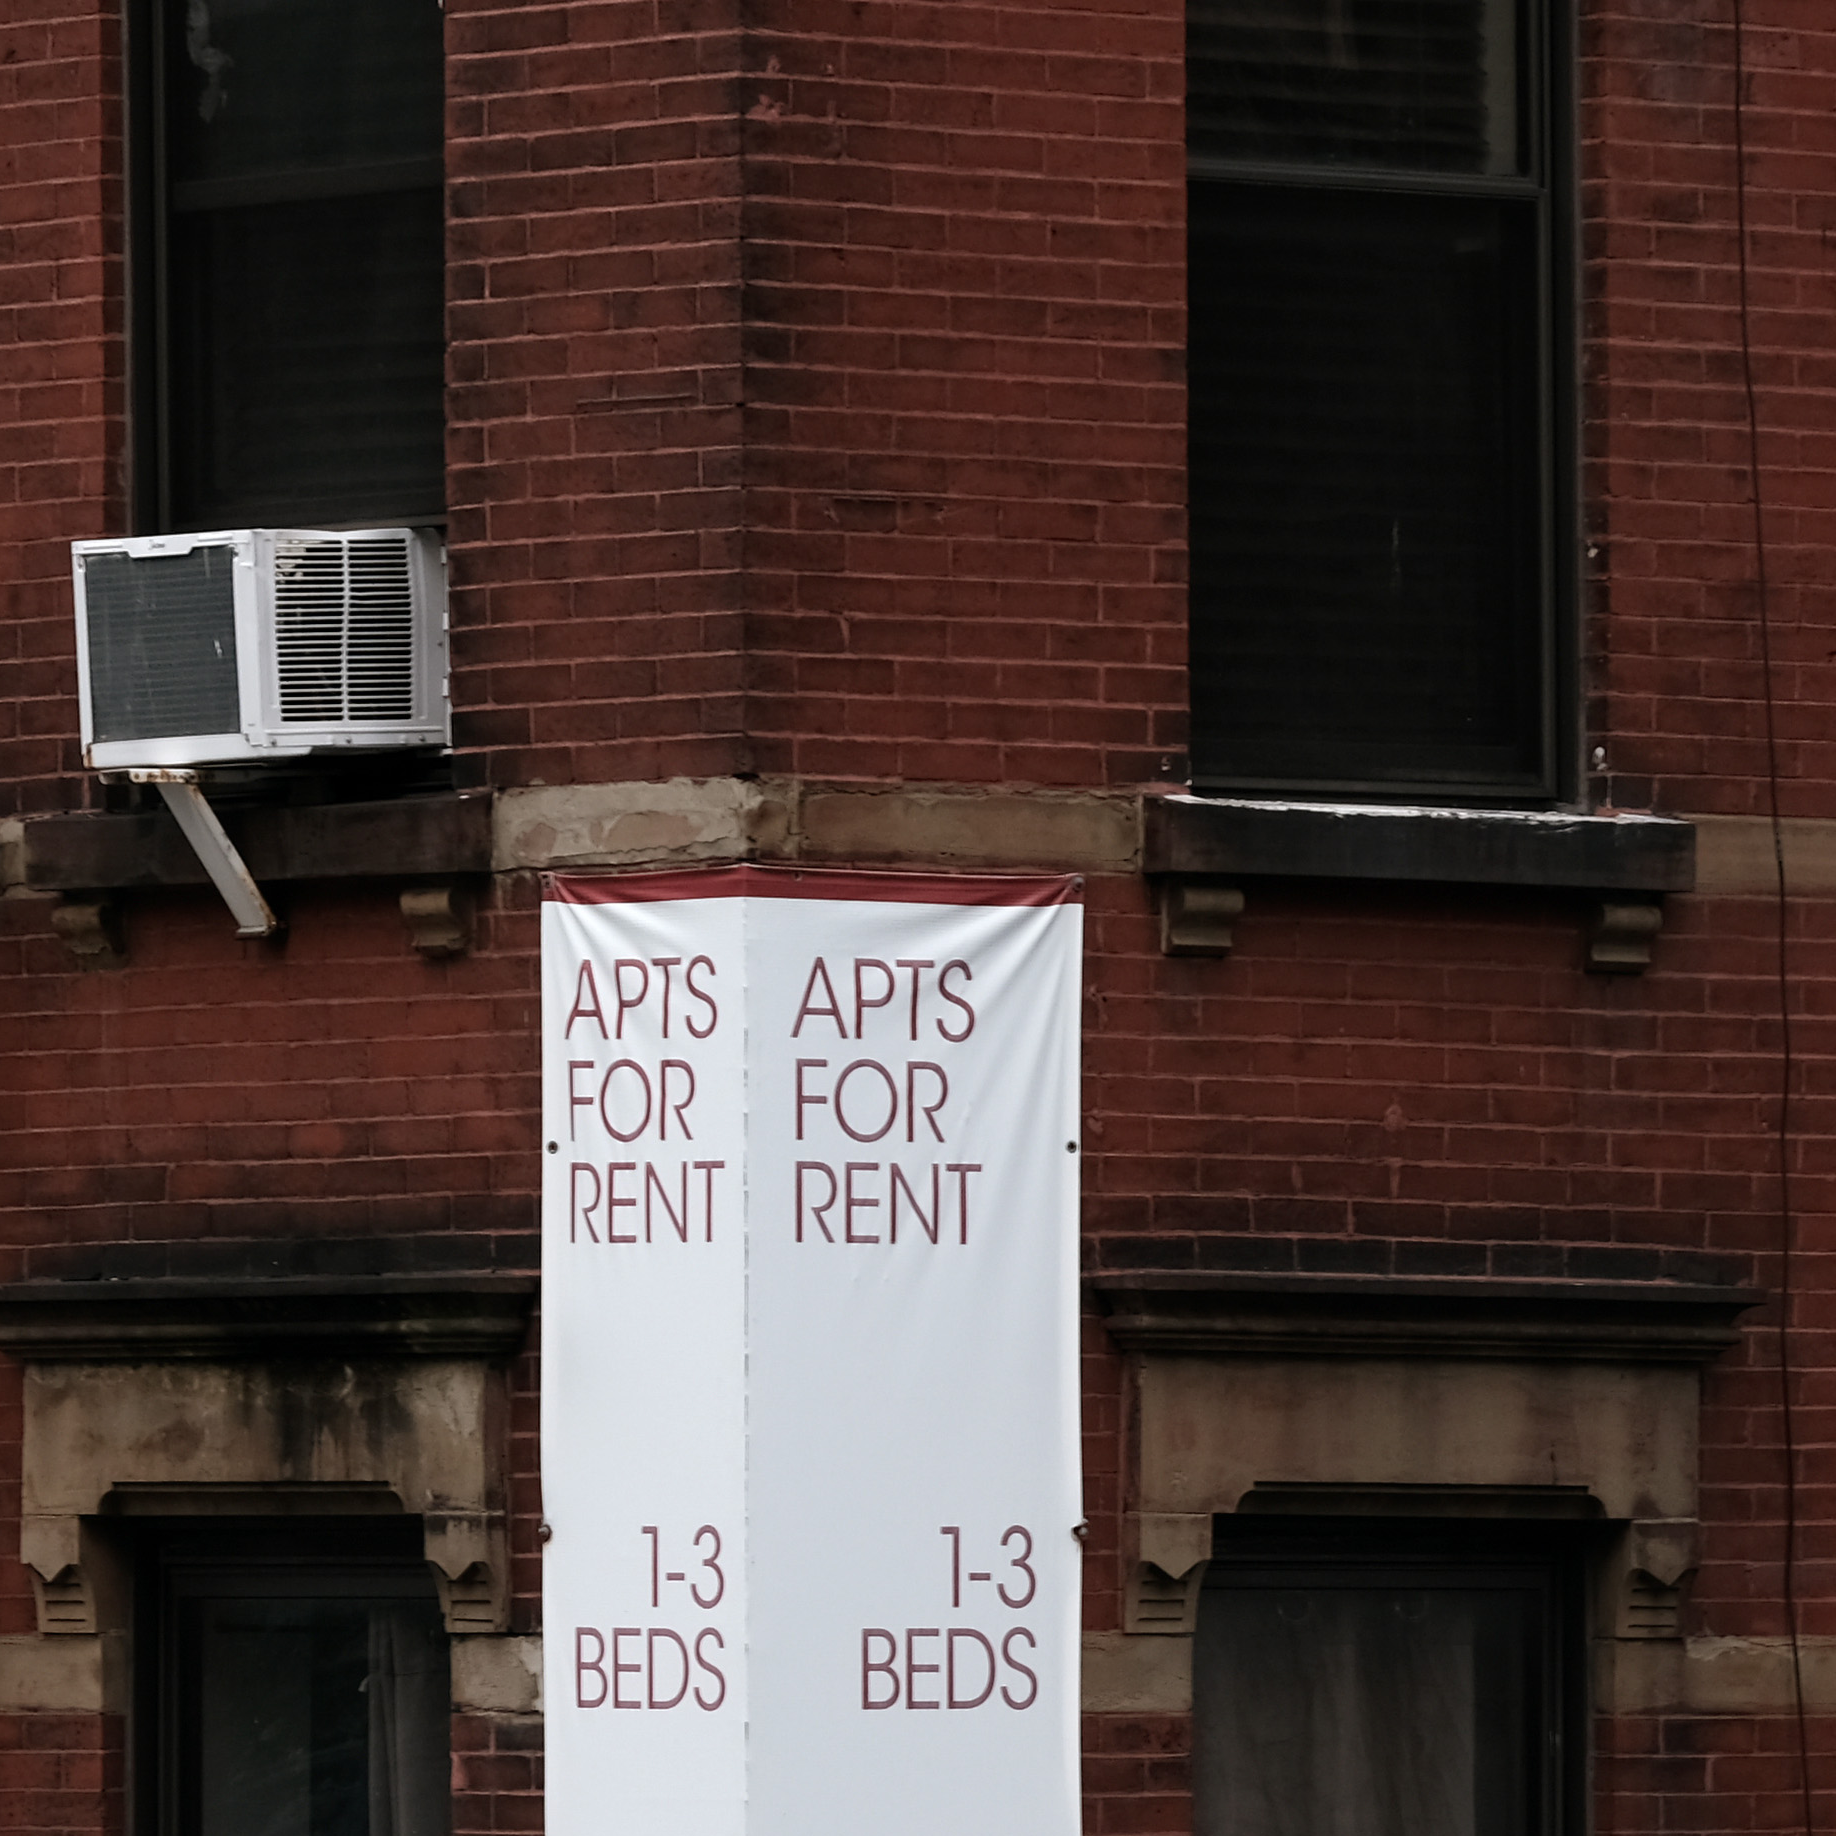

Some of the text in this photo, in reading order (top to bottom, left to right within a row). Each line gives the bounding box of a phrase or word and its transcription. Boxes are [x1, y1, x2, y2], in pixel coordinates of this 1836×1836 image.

[564, 953, 718, 1040] APTS
[790, 955, 976, 1043] APTS
[568, 1058, 695, 1142] FOR
[795, 1058, 949, 1143] FOR
[569, 1160, 725, 1244] RENT
[795, 1160, 983, 1245] RENT
[641, 1524, 725, 1609] 1-3
[940, 1524, 1037, 1609] 1-3
[575, 1626, 726, 1711] BEDS
[861, 1626, 1038, 1710] BEDS
